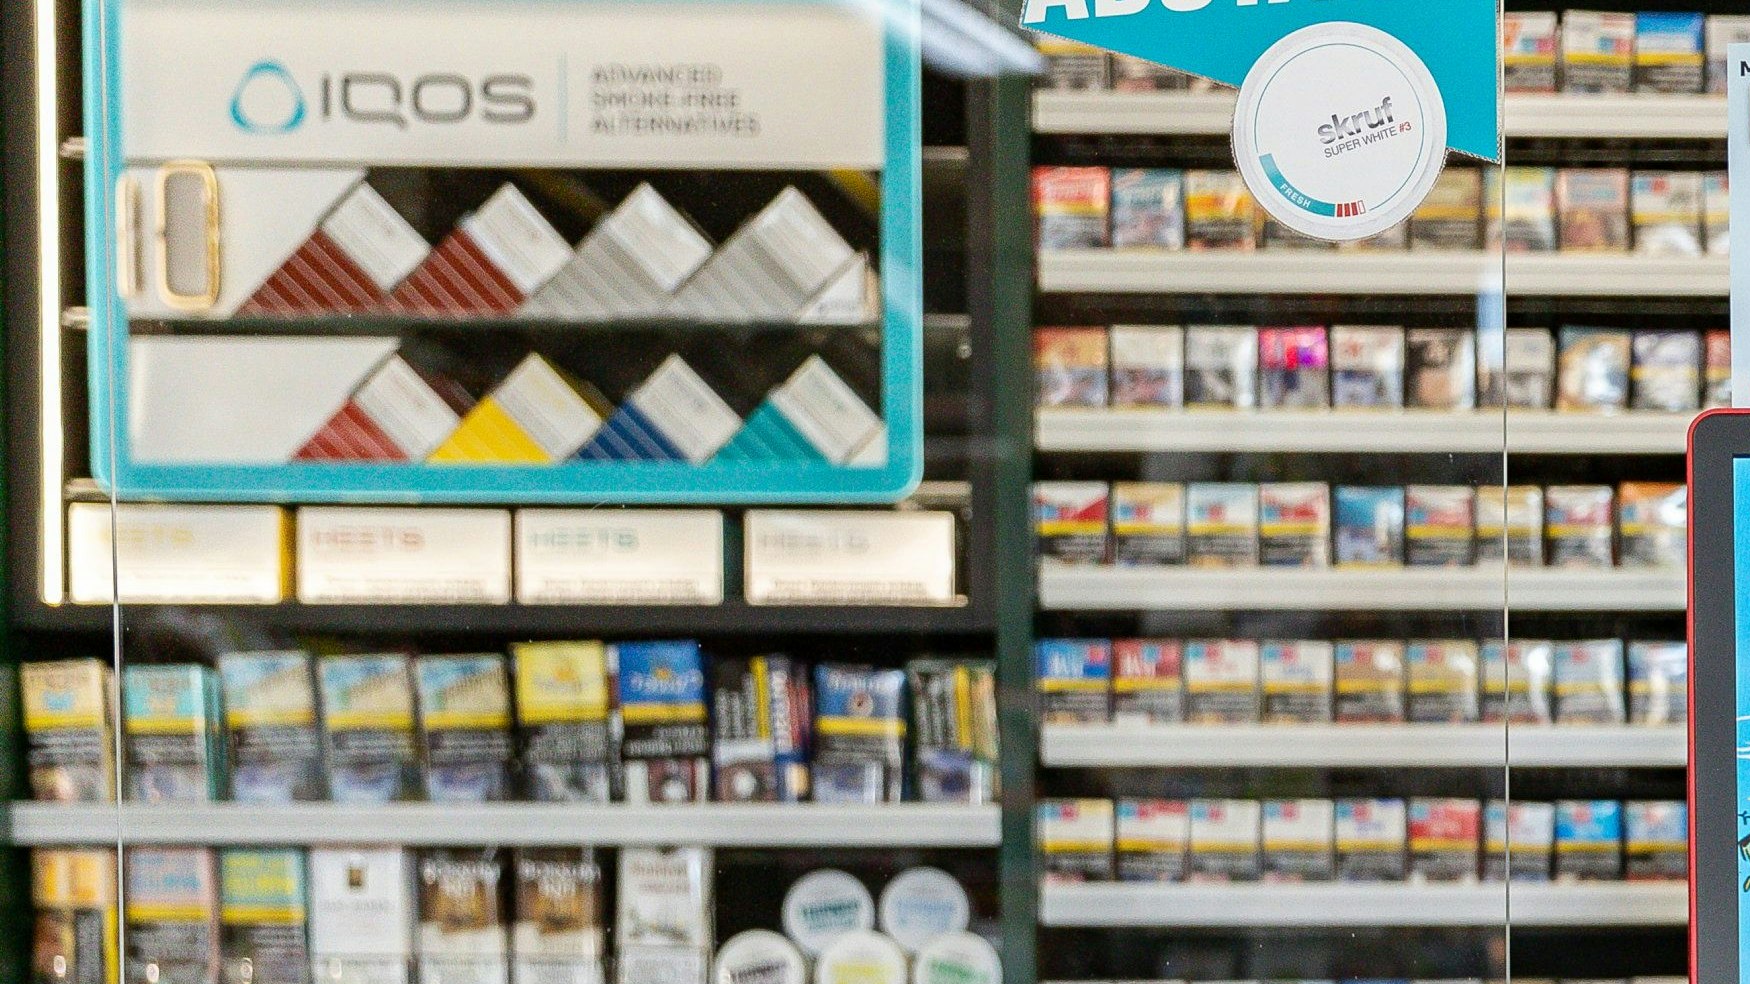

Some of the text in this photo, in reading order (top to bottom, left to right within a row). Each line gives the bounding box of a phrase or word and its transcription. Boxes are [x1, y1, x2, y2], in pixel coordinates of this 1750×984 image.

[319, 72, 537, 129] IQOS
[1317, 96, 1394, 145] skruf
[1324, 121, 1412, 158] SUPER WHITE #3
[1279, 183, 1312, 208] FRESH
